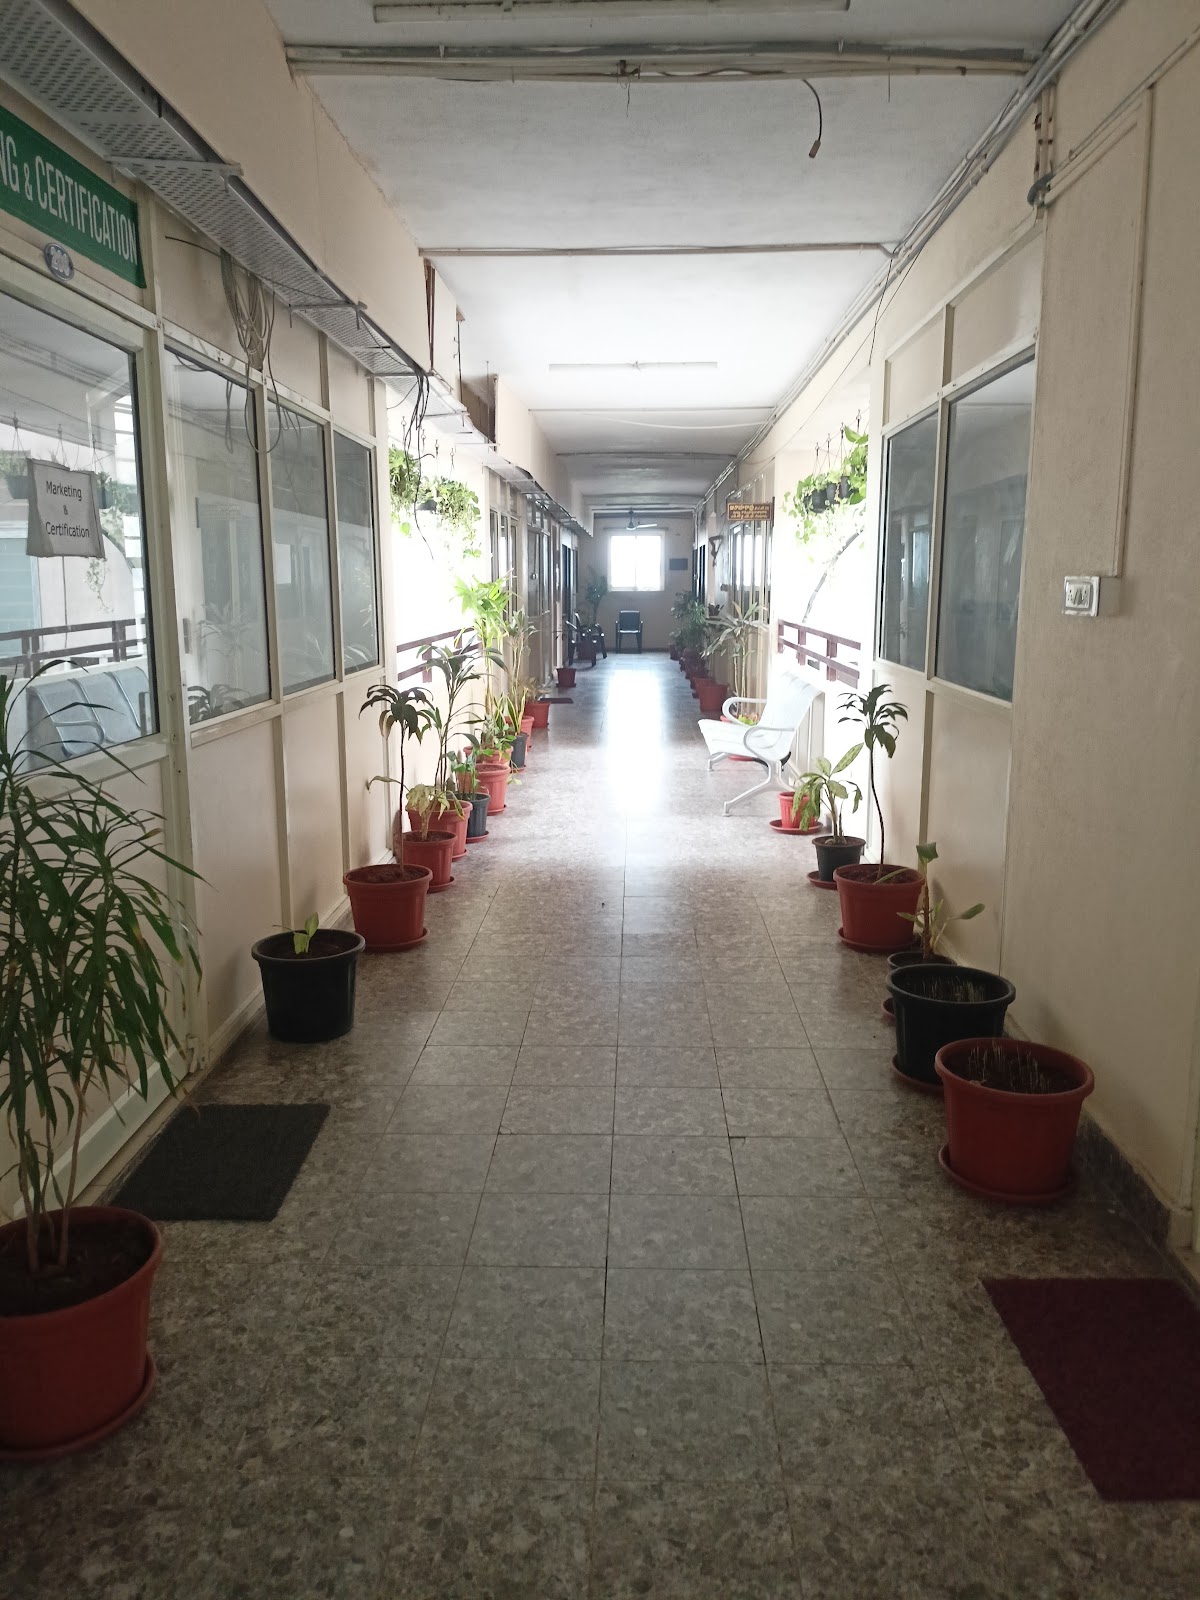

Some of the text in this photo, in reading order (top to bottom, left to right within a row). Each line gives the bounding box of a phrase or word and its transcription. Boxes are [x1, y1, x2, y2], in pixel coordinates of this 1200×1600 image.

[23, 162, 33, 202] &
[35, 155, 139, 266] CERTIFICATION
[46, 481, 82, 501] Marketing
[63, 505, 68, 515] &
[45, 521, 90, 538] Certification
